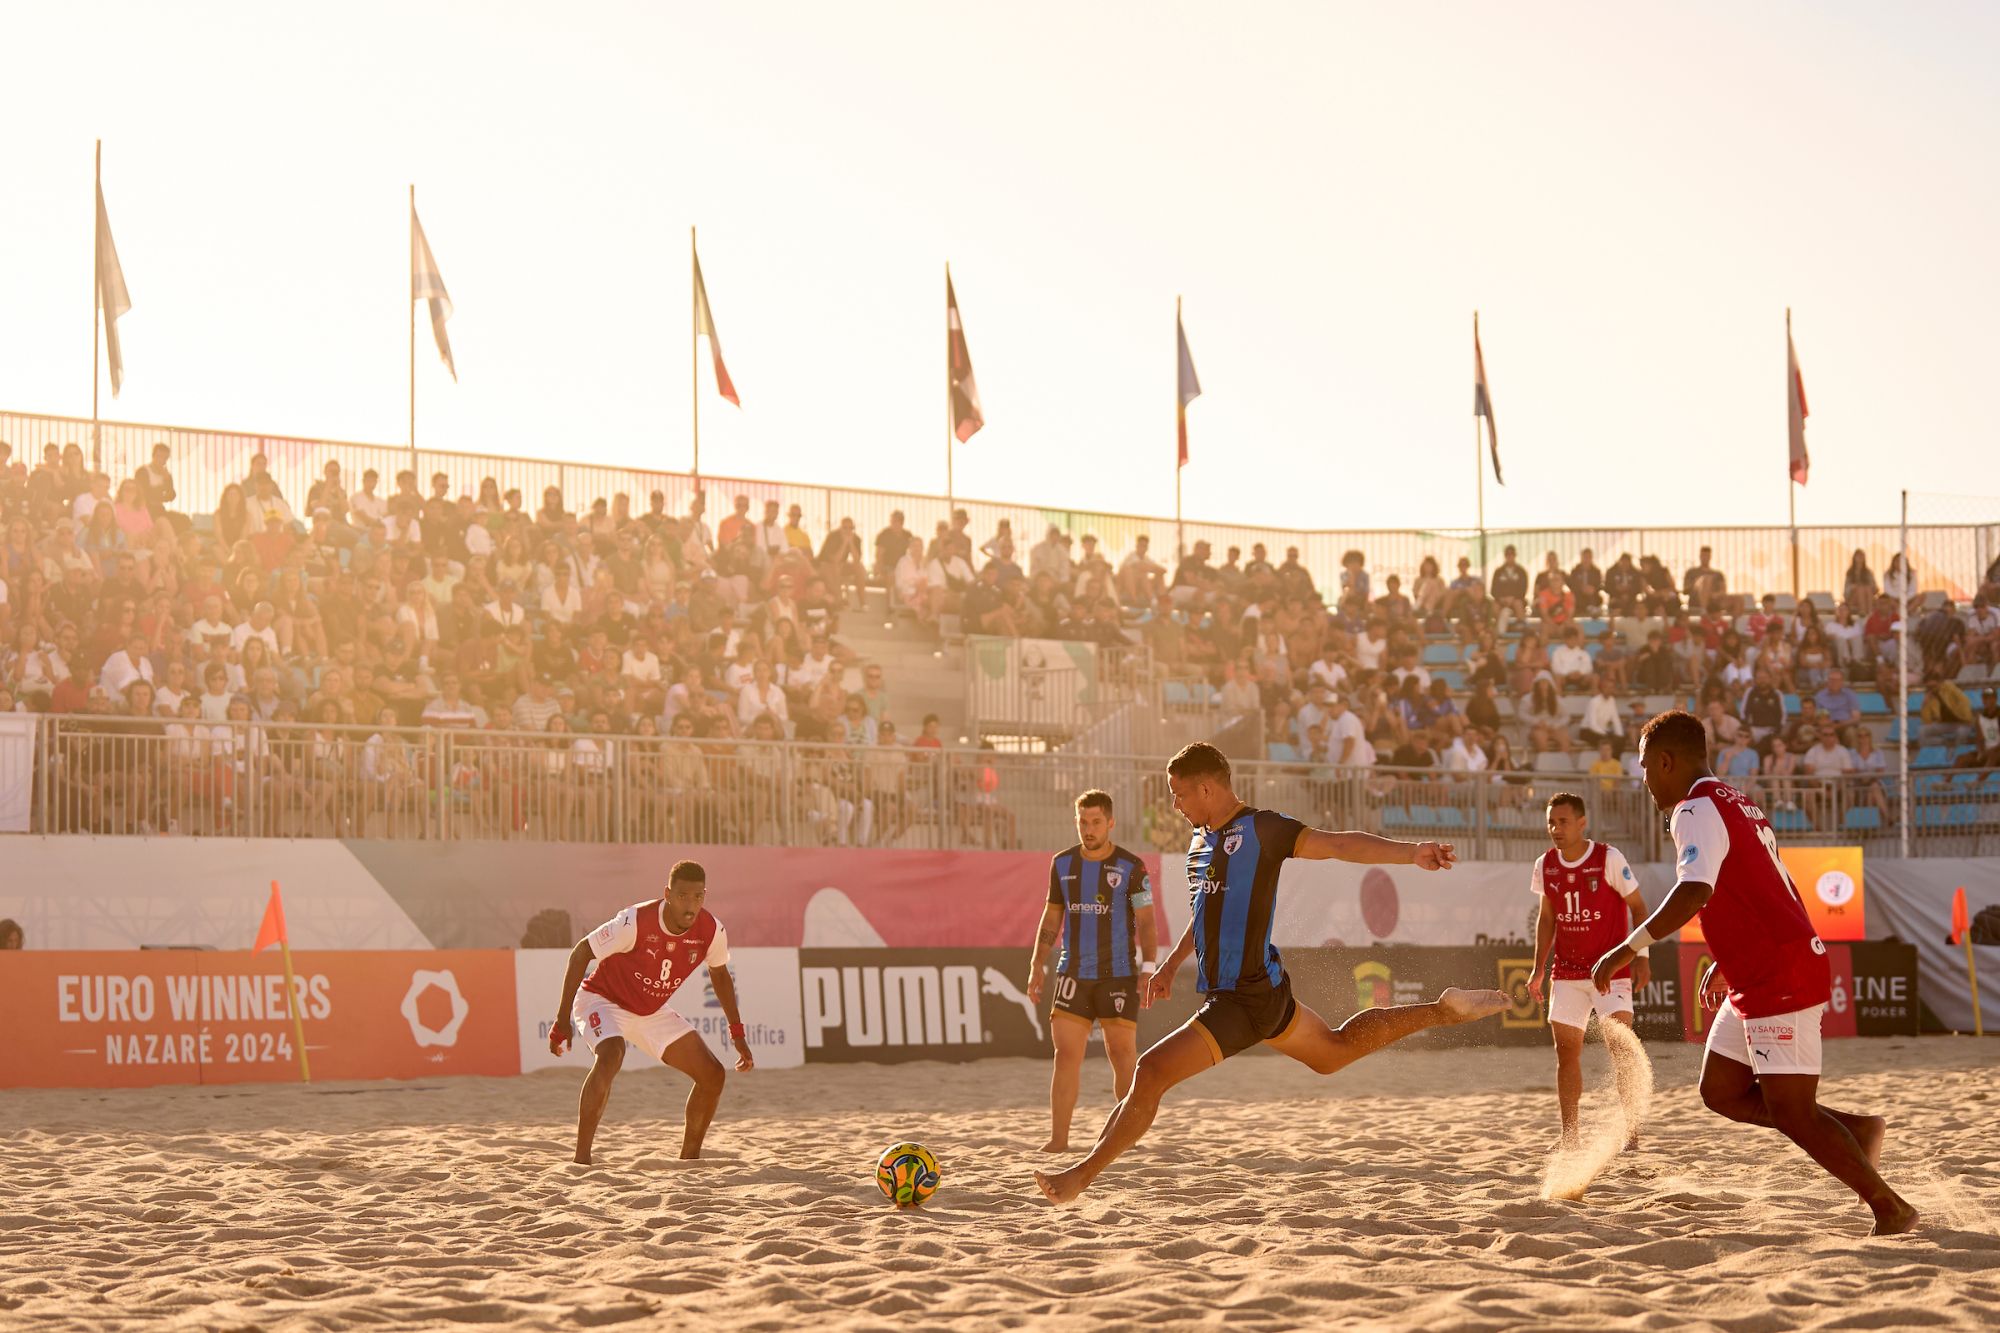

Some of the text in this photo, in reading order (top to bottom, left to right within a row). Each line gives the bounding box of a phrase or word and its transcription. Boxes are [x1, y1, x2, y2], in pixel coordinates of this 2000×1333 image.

[1067, 900, 1109, 914] Lenergy
[1564, 891, 1580, 914] 11
[660, 958, 672, 981] 8
[58, 974, 332, 1022] EURO WINNERS
[1056, 976, 1076, 1000] 10
[803, 965, 983, 1048] PUMA
[1861, 1006, 1907, 1018] POKER
[588, 1011, 601, 1028] 8
[1758, 1026, 1794, 1034] SANTOS
[106, 1027, 294, 1065] NAZARÉ 2024
